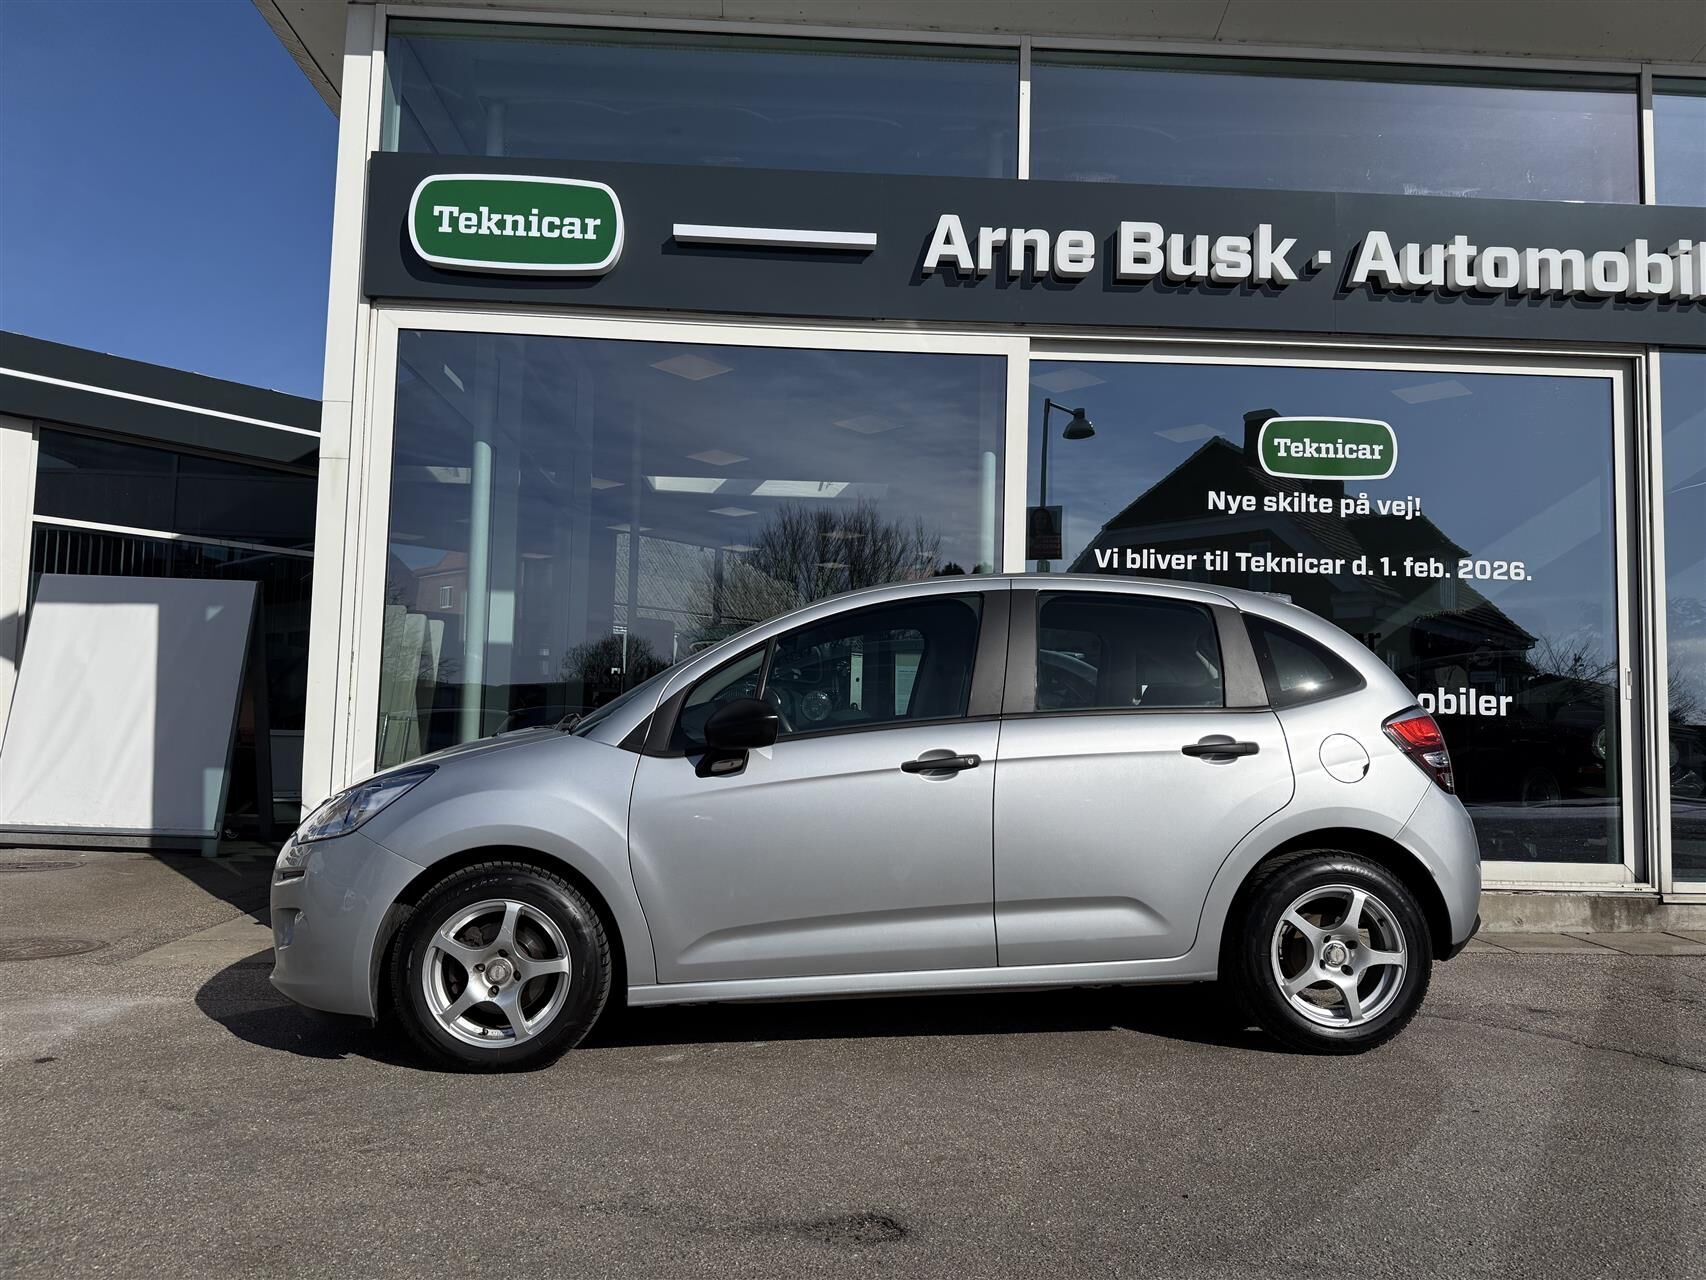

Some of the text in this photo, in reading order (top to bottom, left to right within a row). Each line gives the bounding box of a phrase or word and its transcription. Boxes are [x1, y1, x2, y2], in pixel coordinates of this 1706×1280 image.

[433, 205, 601, 240] Teknicar
[923, 214, 1096, 276] Arne
[1118, 221, 1298, 282] Busk
[1273, 438, 1384, 460] Teknicar
[1207, 491, 1422, 520] Nye skilte på vej!
[1094, 548, 1533, 581] Vi bliver til Teknicar d. 1. feb. 2026.
